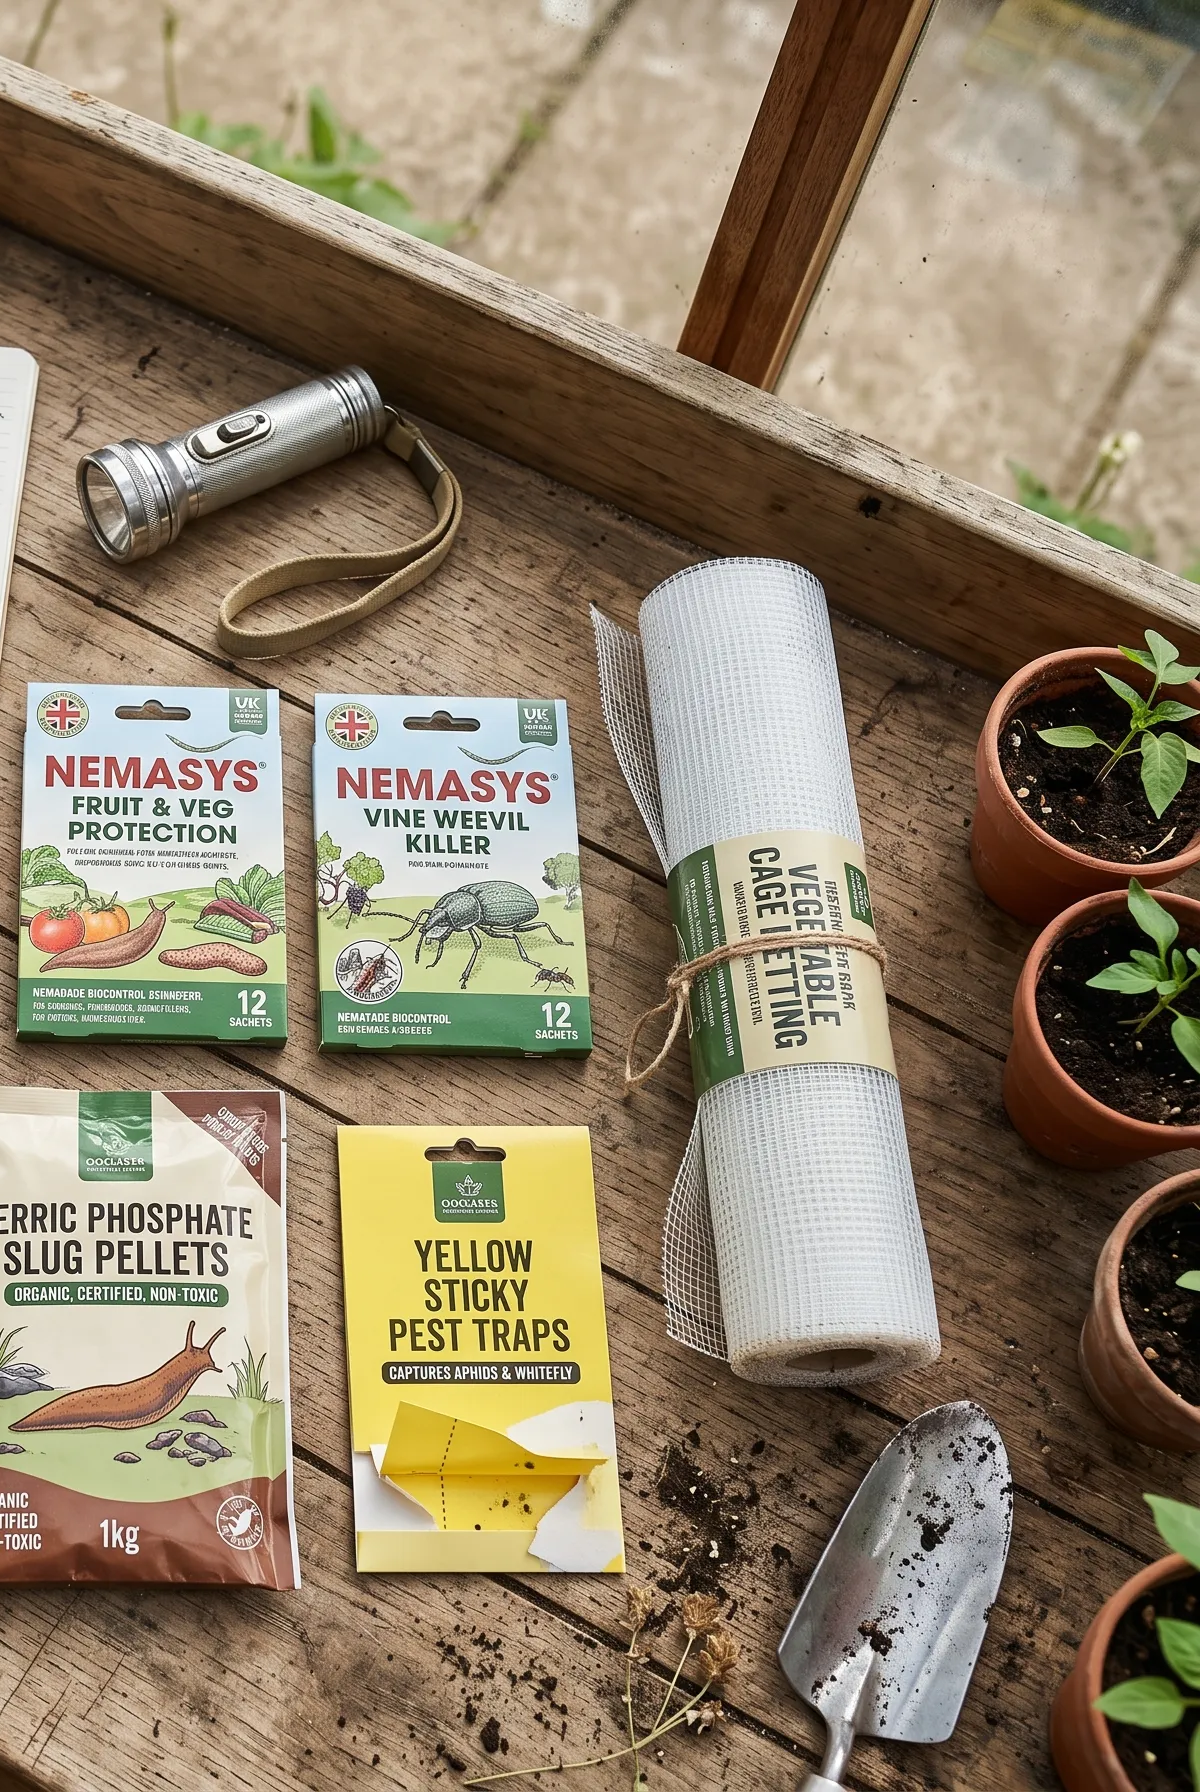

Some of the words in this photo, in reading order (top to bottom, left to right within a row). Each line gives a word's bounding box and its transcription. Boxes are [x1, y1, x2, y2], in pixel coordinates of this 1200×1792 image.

[72, 796, 143, 816] FRUIT
[152, 798, 171, 816] &
[179, 798, 234, 819] VEG
[363, 808, 425, 829] VINE
[433, 809, 530, 832] WEEVIL
[68, 821, 237, 844] PROTECTION
[406, 833, 491, 855] KILLER
[748, 846, 790, 919] CAGE
[88, 989, 146, 1000] BIOCONTROL
[237, 989, 267, 1016] 12
[229, 1017, 273, 1028] SACHETS
[337, 1012, 390, 1023] NEMATADE
[392, 1013, 452, 1024] BIOCONTROL
[541, 1001, 572, 1028] 12
[535, 1029, 579, 1040] SACHETS
[88, 1202, 254, 1241] PHOSPHATE
[3, 1240, 83, 1276] SLUG
[95, 1240, 230, 1277] PELLETS
[414, 1239, 533, 1273] YELLOW
[14, 1286, 74, 1303] ORGANIC,
[77, 1286, 146, 1303] CERTIFIED,
[150, 1287, 219, 1303] NON-TOXIC
[424, 1278, 529, 1312] STICKY
[389, 1318, 463, 1352] PEST
[471, 1318, 571, 1353] TRAPS
[389, 1365, 452, 1380] CAPTURES
[454, 1366, 498, 1380] APHIDS
[501, 1366, 512, 1380] &
[514, 1366, 574, 1381] WHITEFLY
[99, 1518, 140, 1556] 1kg
